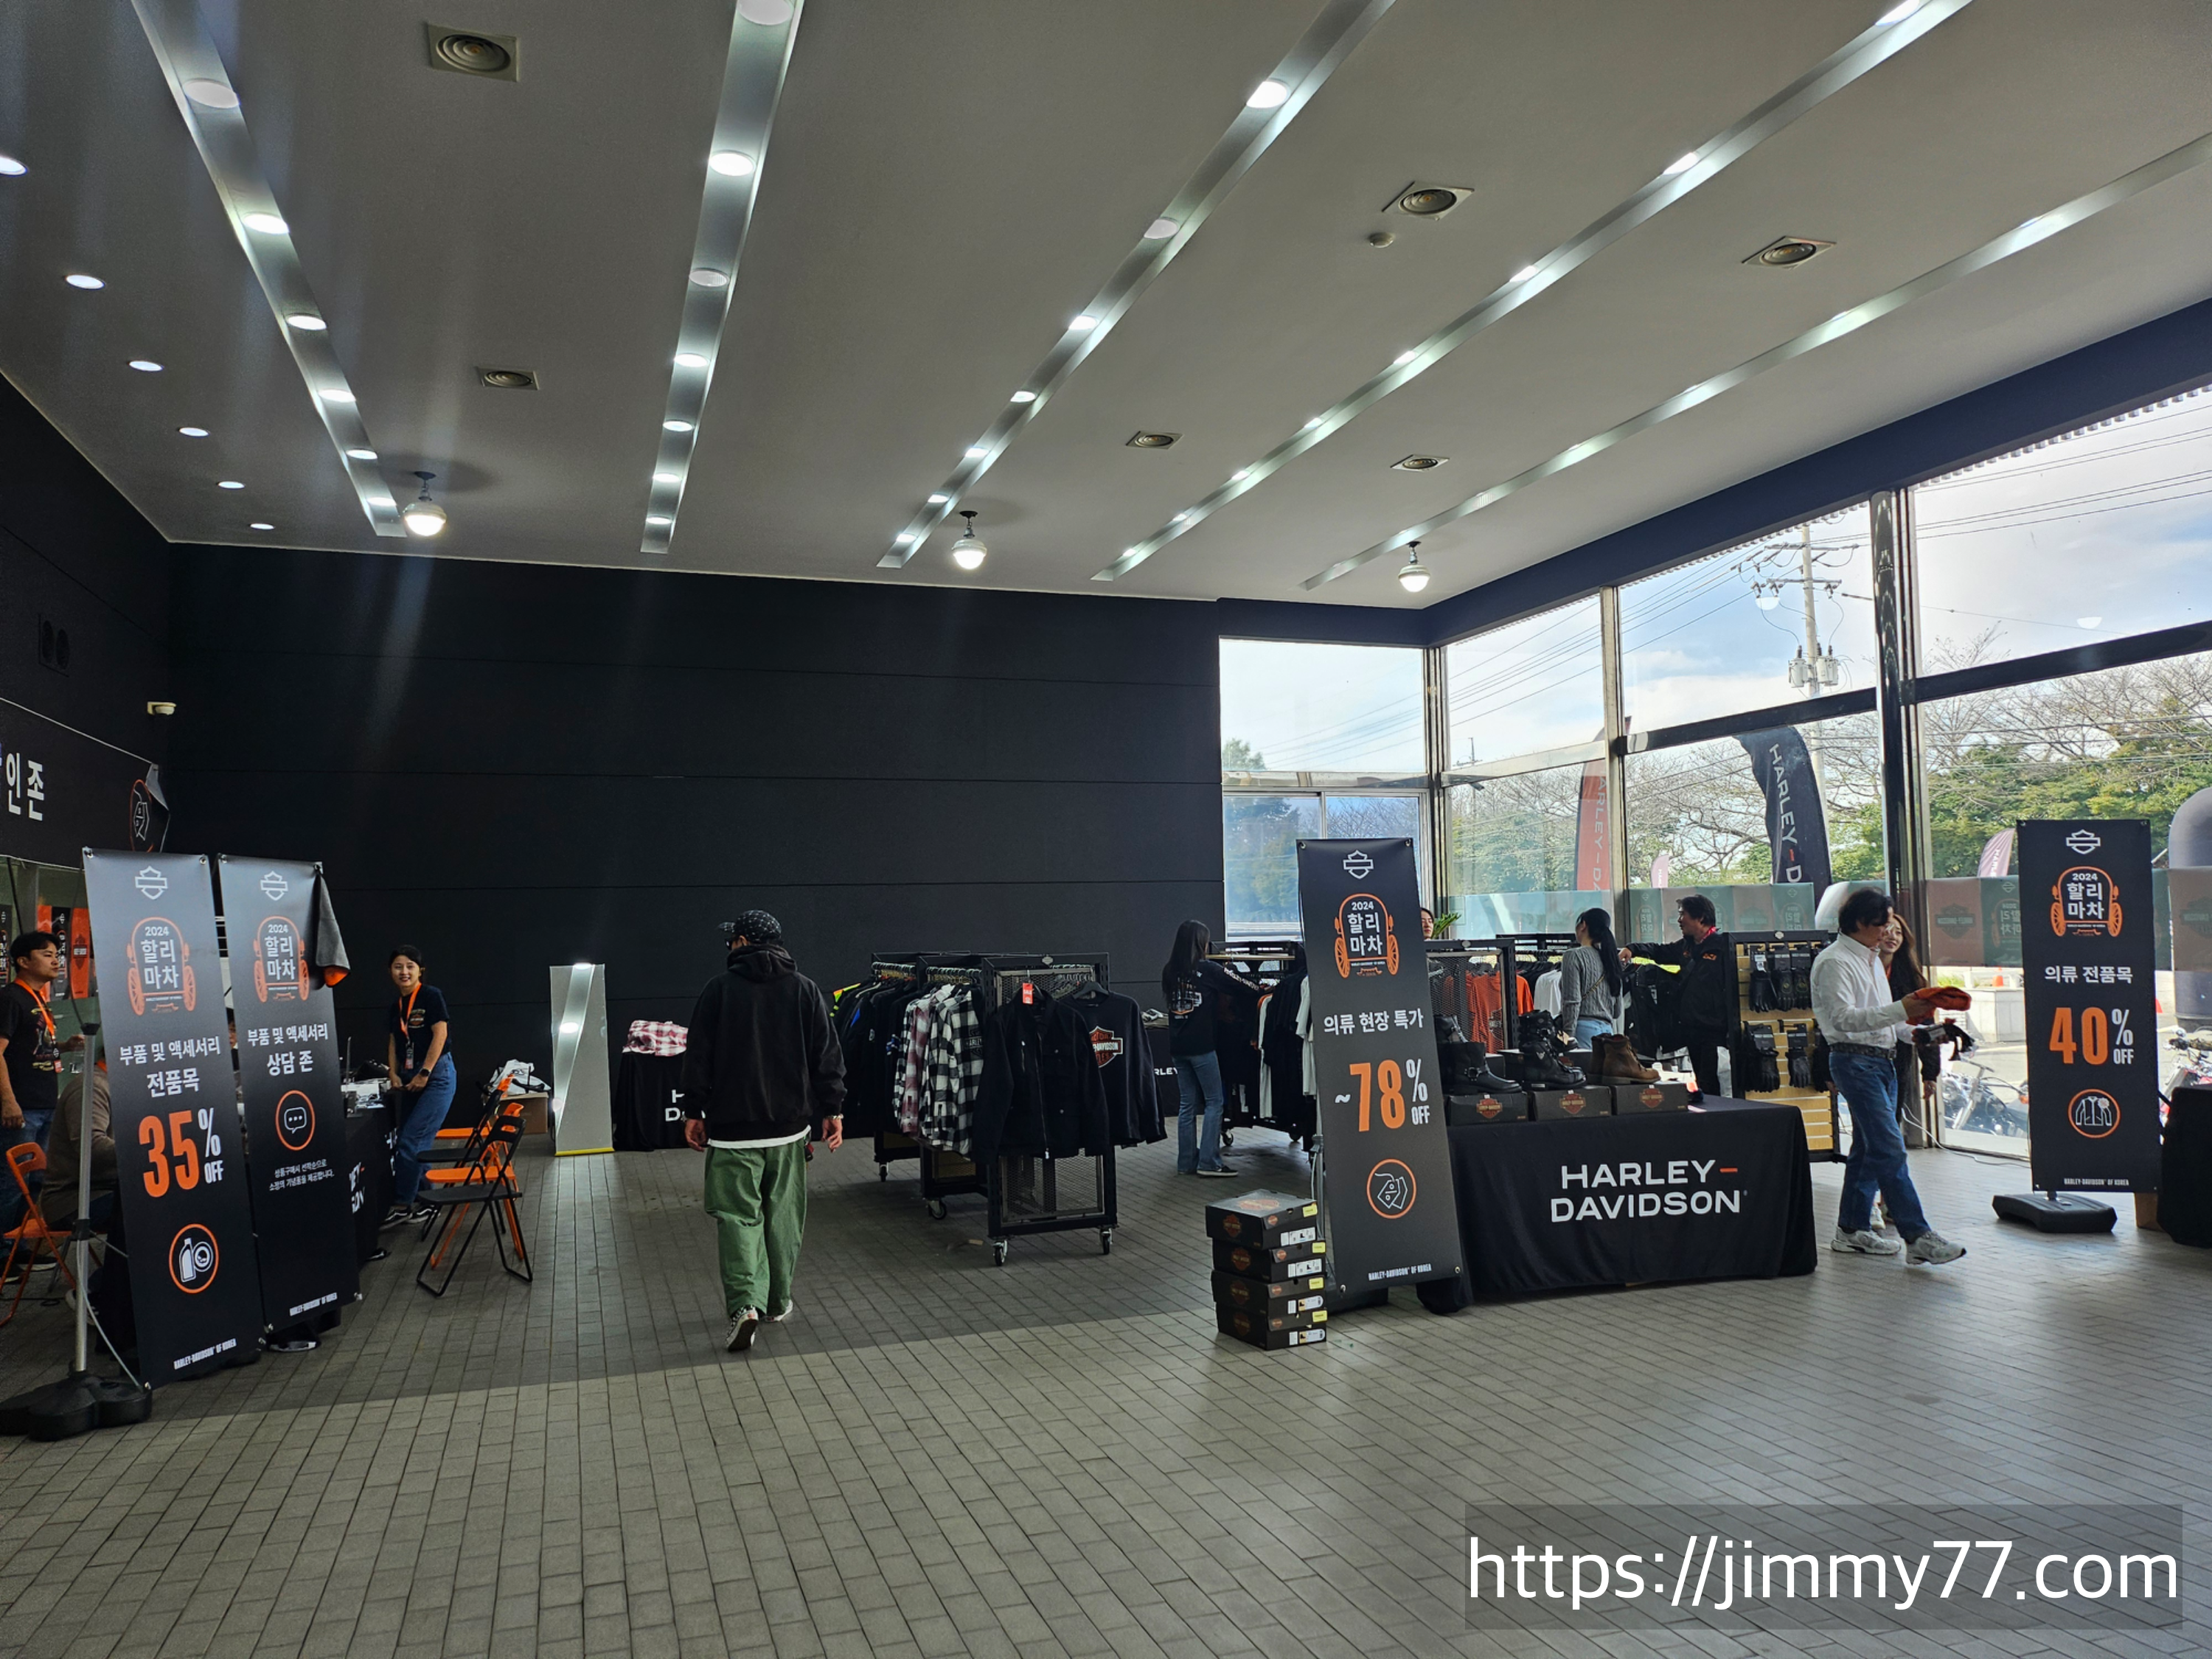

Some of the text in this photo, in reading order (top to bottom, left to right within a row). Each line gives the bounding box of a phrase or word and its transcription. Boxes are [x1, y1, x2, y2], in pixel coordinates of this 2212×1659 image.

[1770, 743, 1802, 883] HARLEY-D
[2072, 873, 2098, 881] 2024
[2067, 882, 2103, 900] 할리
[1352, 901, 1374, 911] 2024
[2067, 901, 2104, 920] 마차
[145, 926, 170, 936] 2024
[268, 924, 288, 933] 2024
[1347, 912, 1380, 934] 할리
[140, 939, 176, 963] 할리
[264, 936, 293, 957] 할리
[1350, 934, 1383, 956] 마차
[144, 964, 179, 990] 마차
[267, 959, 296, 981] 마차
[2045, 965, 2133, 984] 의류 전품목
[1324, 1007, 1424, 1035] 의류 현장 특가
[248, 1023, 328, 1047] 부품 및 액세서리
[120, 1036, 221, 1066] 부품 및 액세서리
[2112, 1048, 2135, 1065] OFF
[267, 1050, 313, 1077] 상담 존
[147, 1068, 200, 1098] 전품목
[1411, 1105, 1430, 1125] OFF
[204, 1160, 224, 1184] OFF
